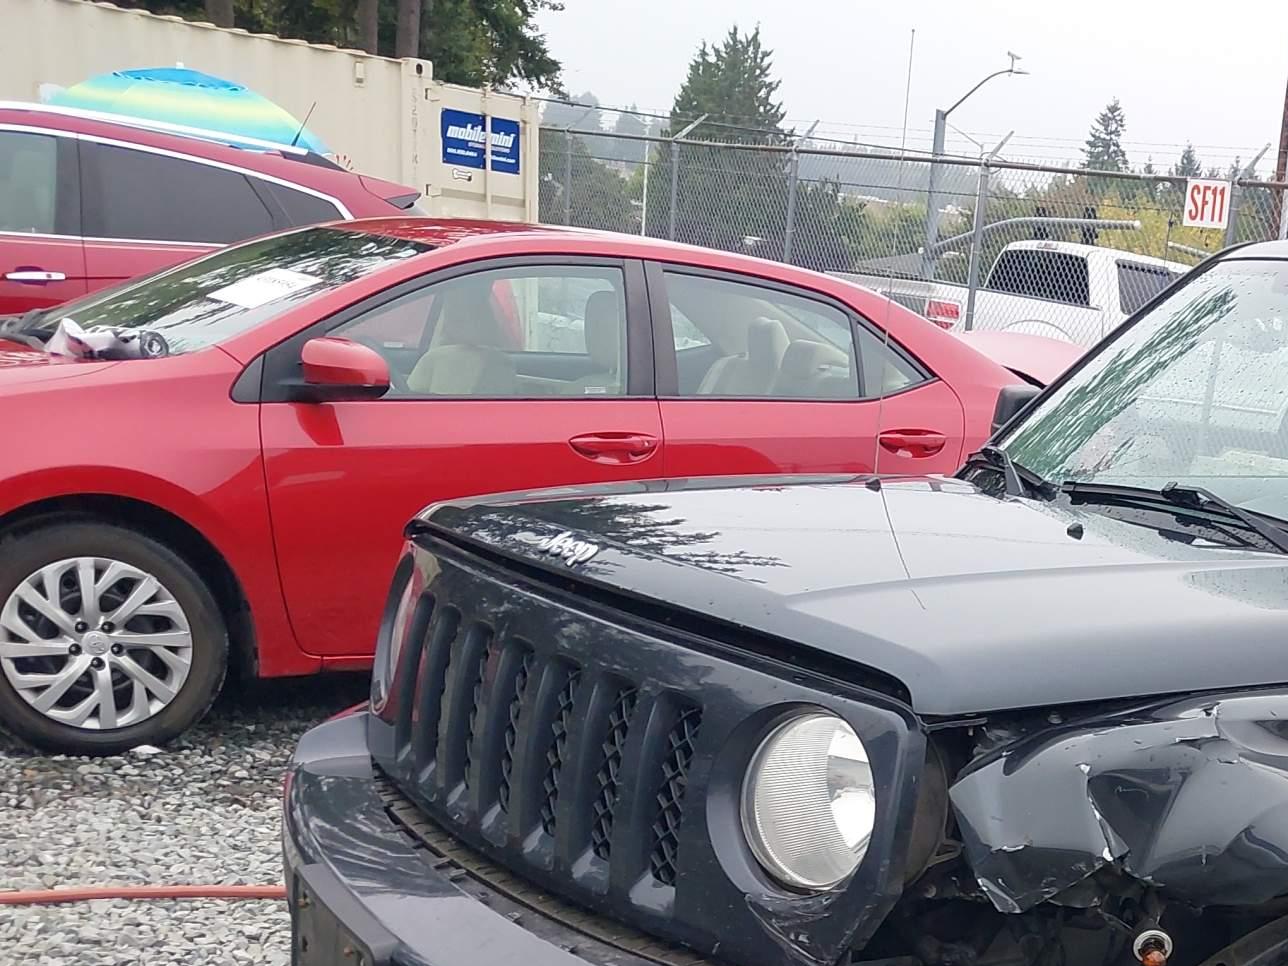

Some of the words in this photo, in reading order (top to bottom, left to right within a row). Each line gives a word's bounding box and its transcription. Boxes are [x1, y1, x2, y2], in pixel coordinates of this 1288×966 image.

[446, 123, 486, 143] mobile
[490, 131, 516, 148] mini
[1188, 184, 1226, 223] SF11
[537, 530, 599, 567] Jeep
